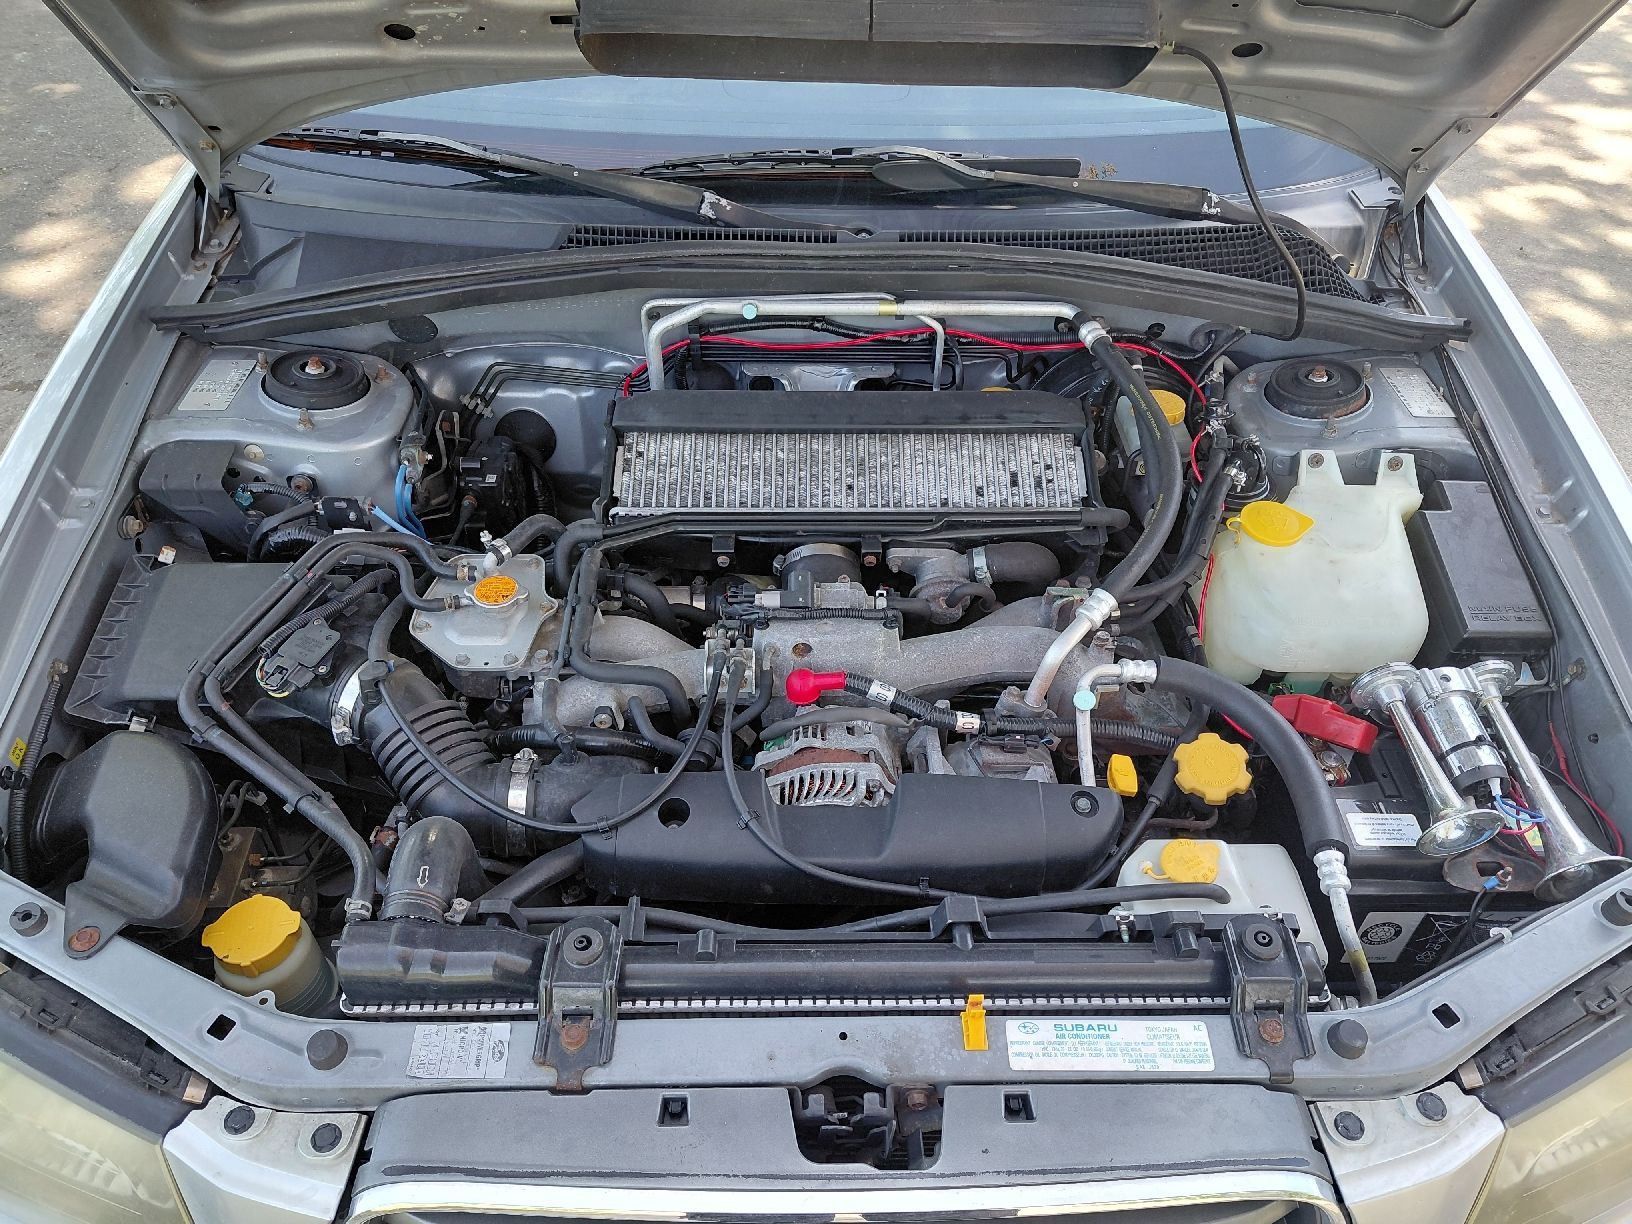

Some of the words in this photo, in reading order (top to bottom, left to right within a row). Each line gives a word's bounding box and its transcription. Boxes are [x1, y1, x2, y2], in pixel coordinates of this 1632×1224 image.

[1053, 1023, 1118, 1032] SUBARU
[1055, 1032, 1067, 1040] AIR
[1067, 1032, 1111, 1040] CONDITIONER
